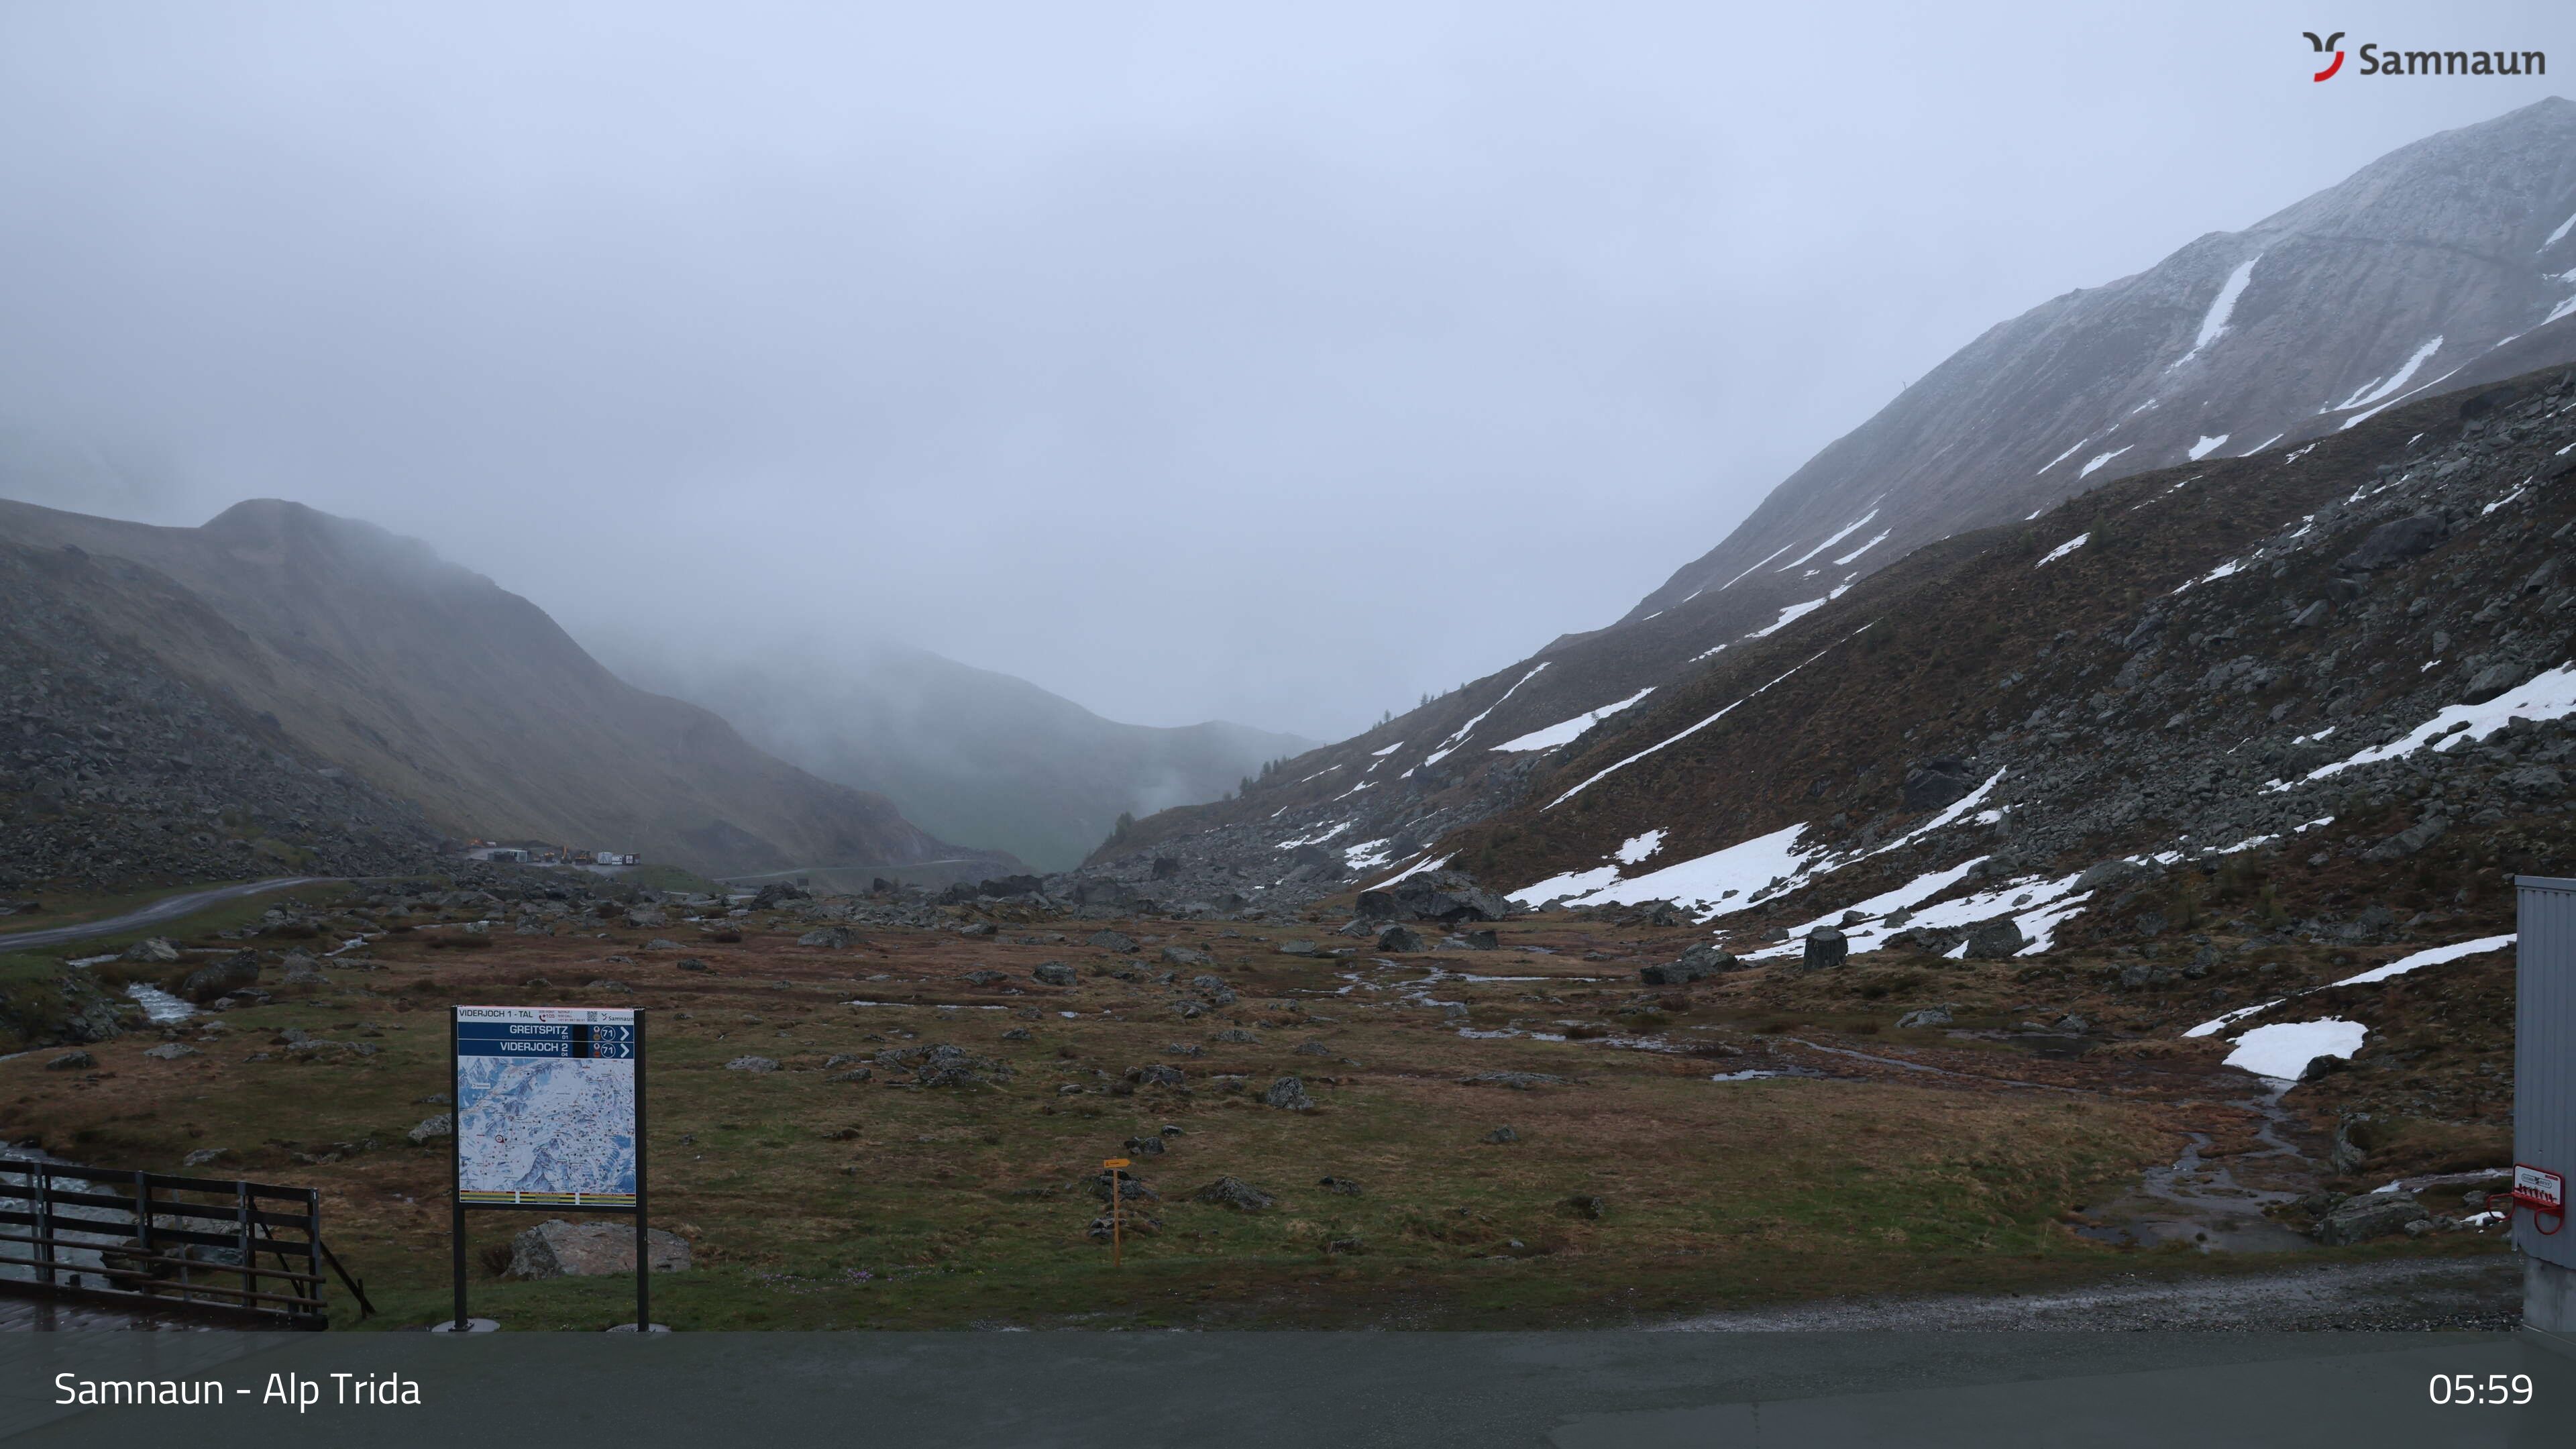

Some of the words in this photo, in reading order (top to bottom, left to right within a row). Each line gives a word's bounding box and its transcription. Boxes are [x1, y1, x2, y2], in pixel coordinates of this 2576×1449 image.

[459, 1010, 505, 1018] VIDERJOCH
[519, 1010, 533, 1018] TAL
[509, 1025, 568, 1035] GREITSPITZ
[602, 1029, 613, 1037] 71
[500, 1042, 559, 1052] VIDERJOCH
[561, 1042, 568, 1052] 2
[602, 1046, 613, 1054] 71
